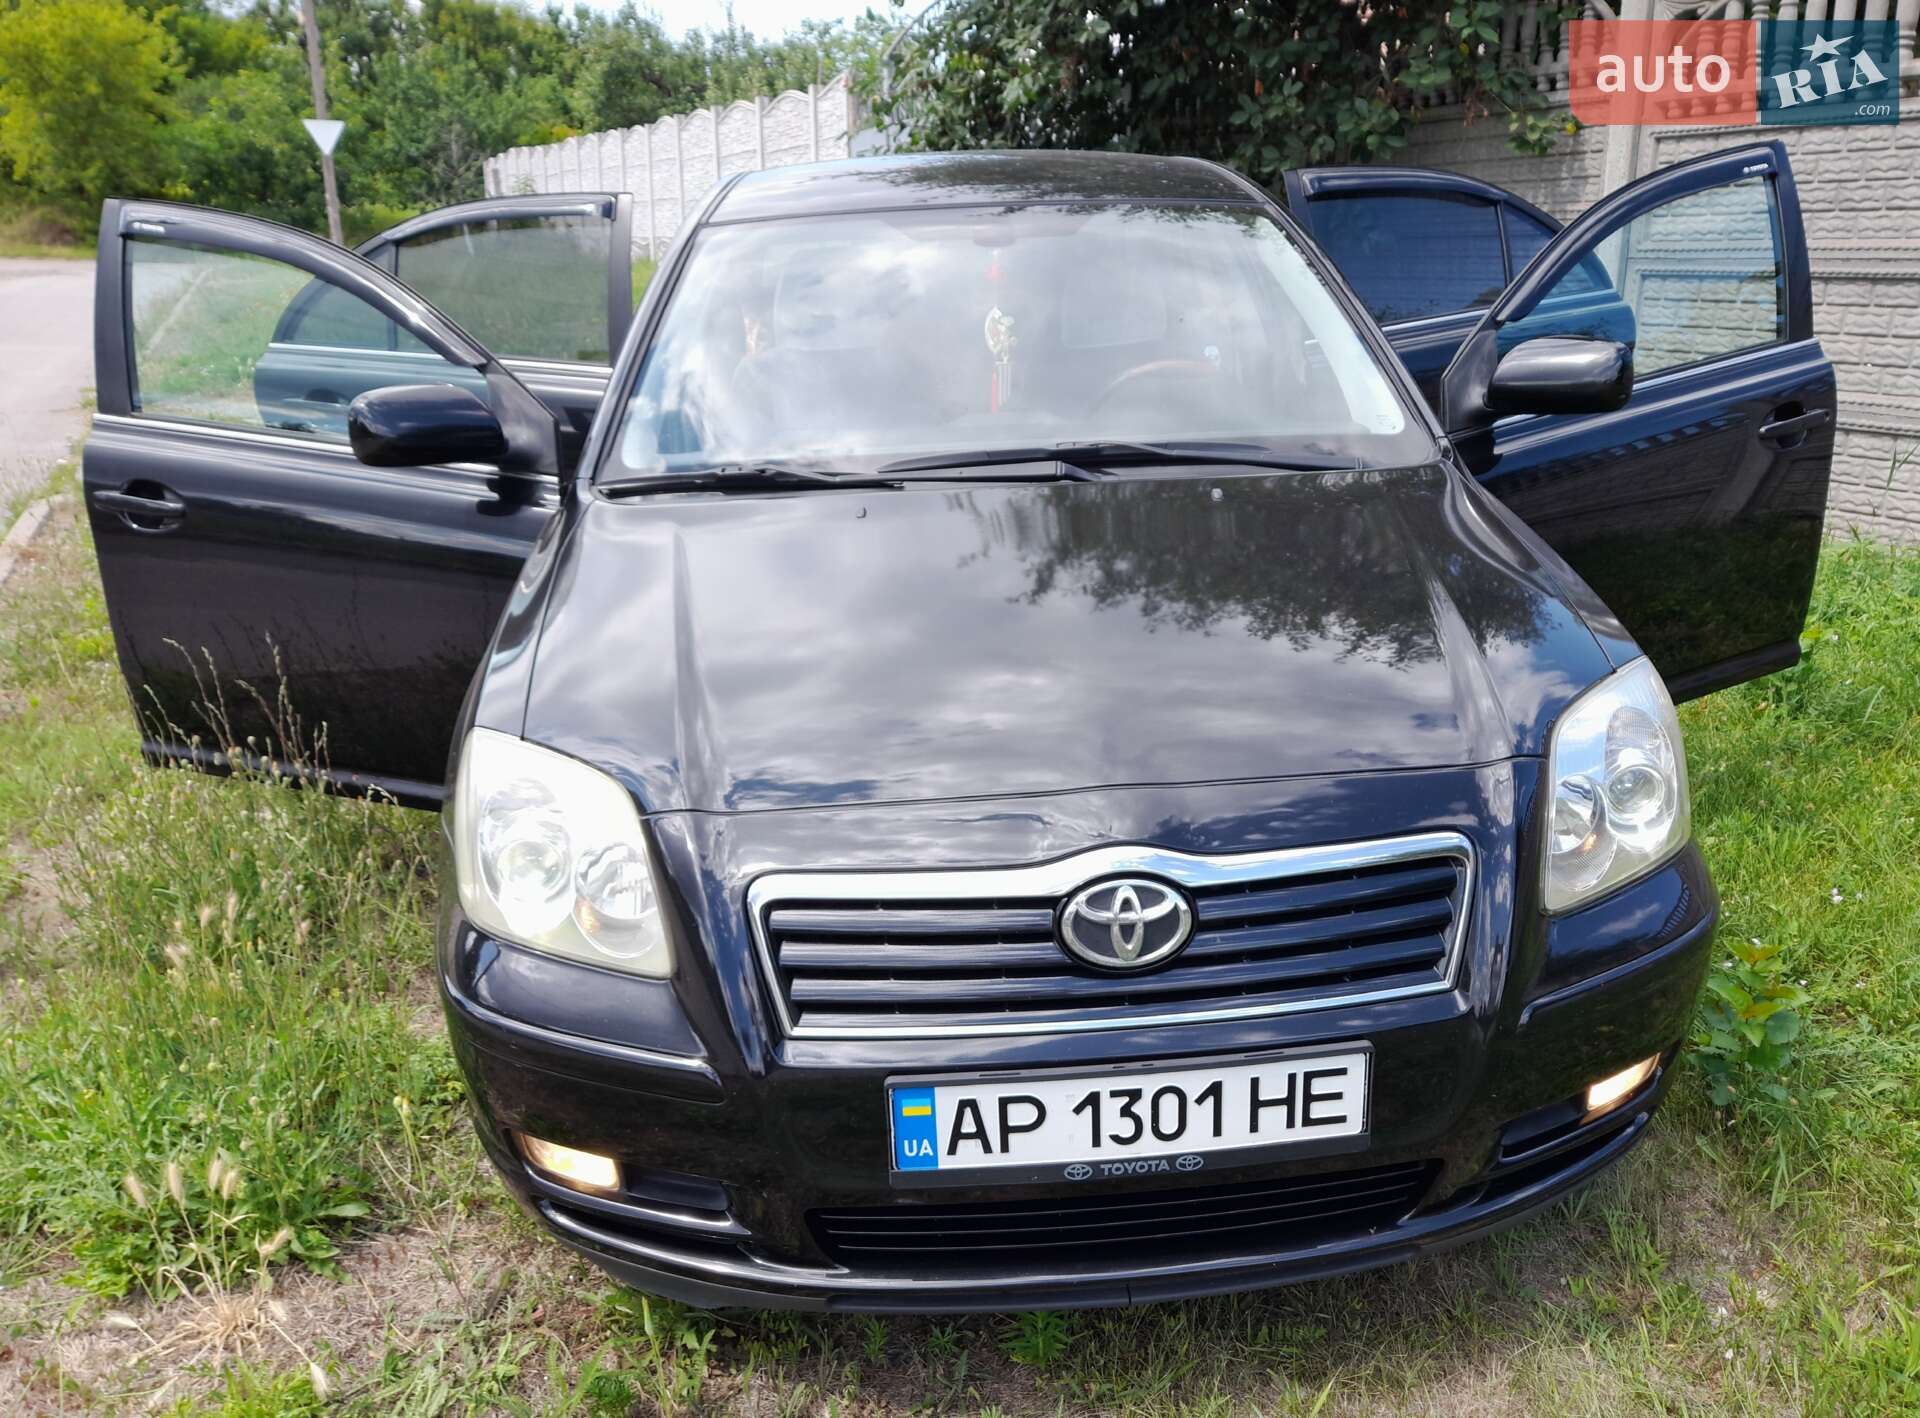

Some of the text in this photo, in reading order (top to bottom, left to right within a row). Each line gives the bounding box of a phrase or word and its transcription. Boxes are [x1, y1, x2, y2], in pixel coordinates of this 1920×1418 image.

[946, 1067, 1348, 1155] AP 1301 HE
[904, 1139, 934, 1156] UA
[1101, 1160, 1170, 1176] TOYOTA
